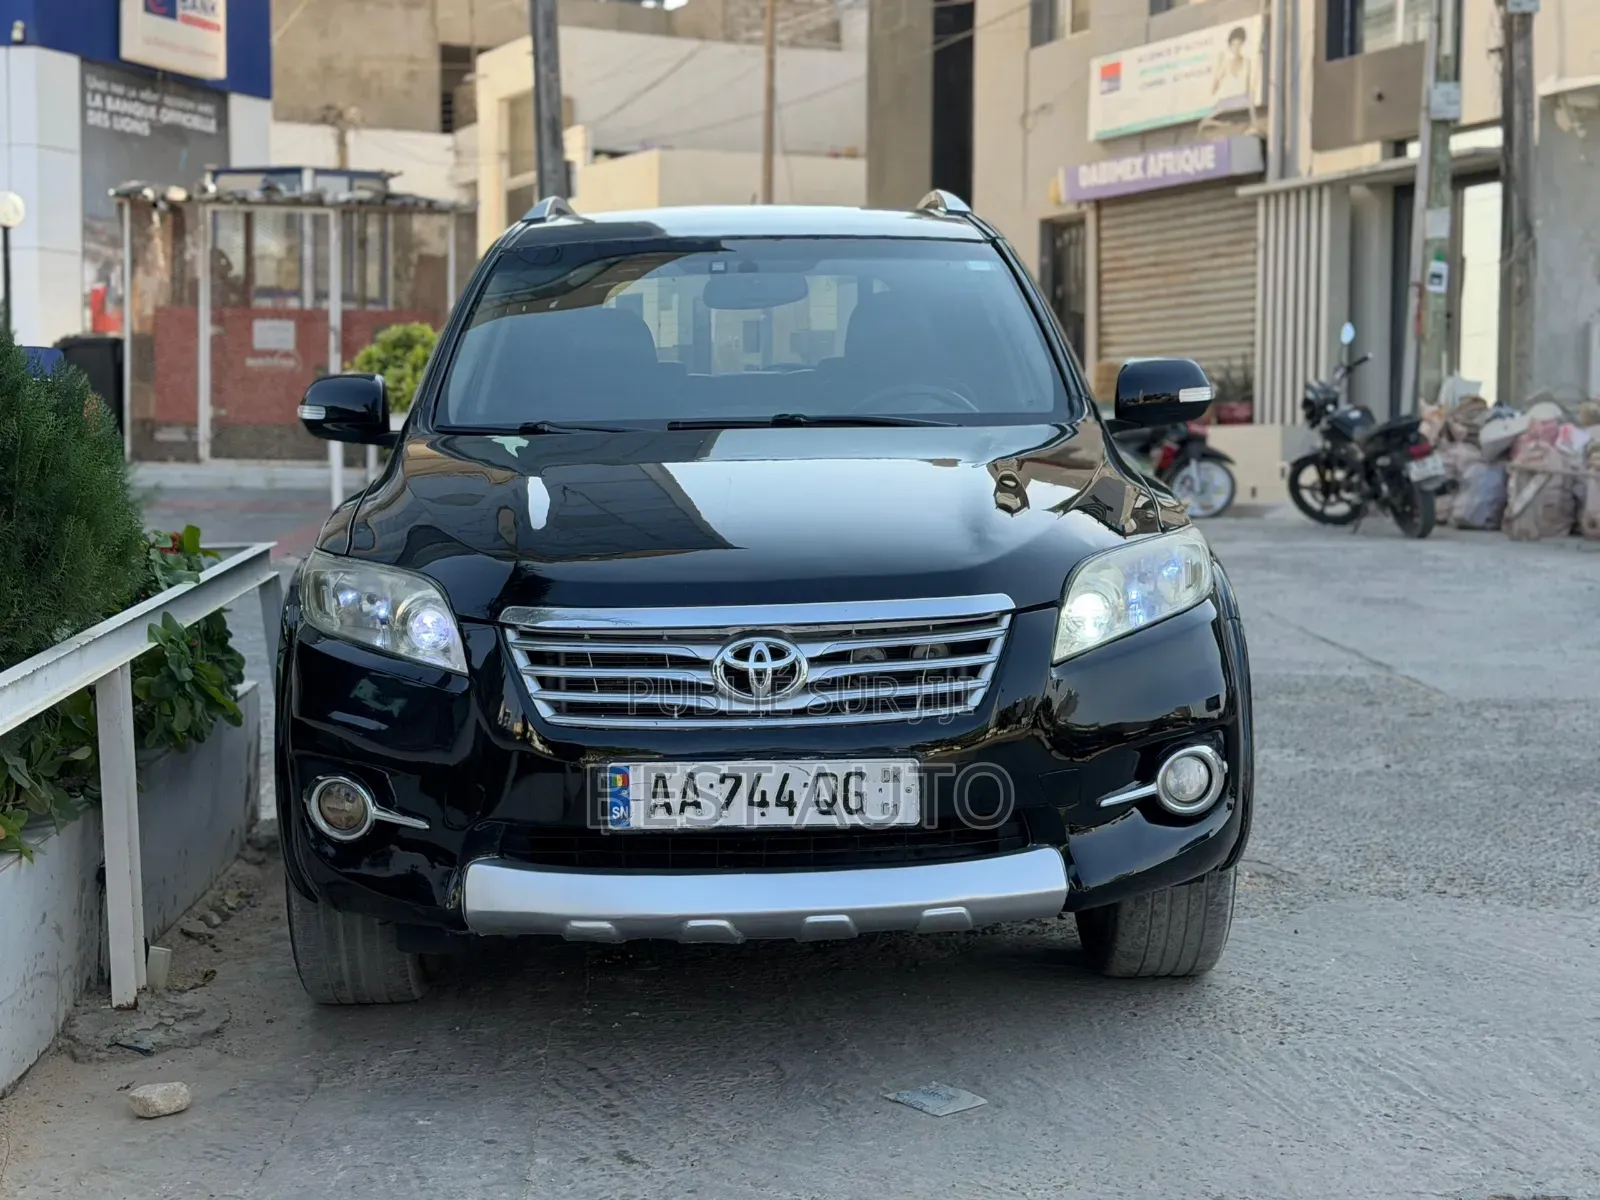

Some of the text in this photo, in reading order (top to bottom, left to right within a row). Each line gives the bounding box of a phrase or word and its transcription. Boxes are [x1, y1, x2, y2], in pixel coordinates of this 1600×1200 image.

[86, 91, 103, 108] LA
[105, 95, 158, 120] BANQUE
[87, 109, 151, 136] DES LIONS
[1146, 144, 1216, 178] AFRIQUE
[881, 767, 902, 783] DK
[650, 771, 704, 817] AA
[718, 772, 797, 818] 744
[611, 805, 629, 820] SN
